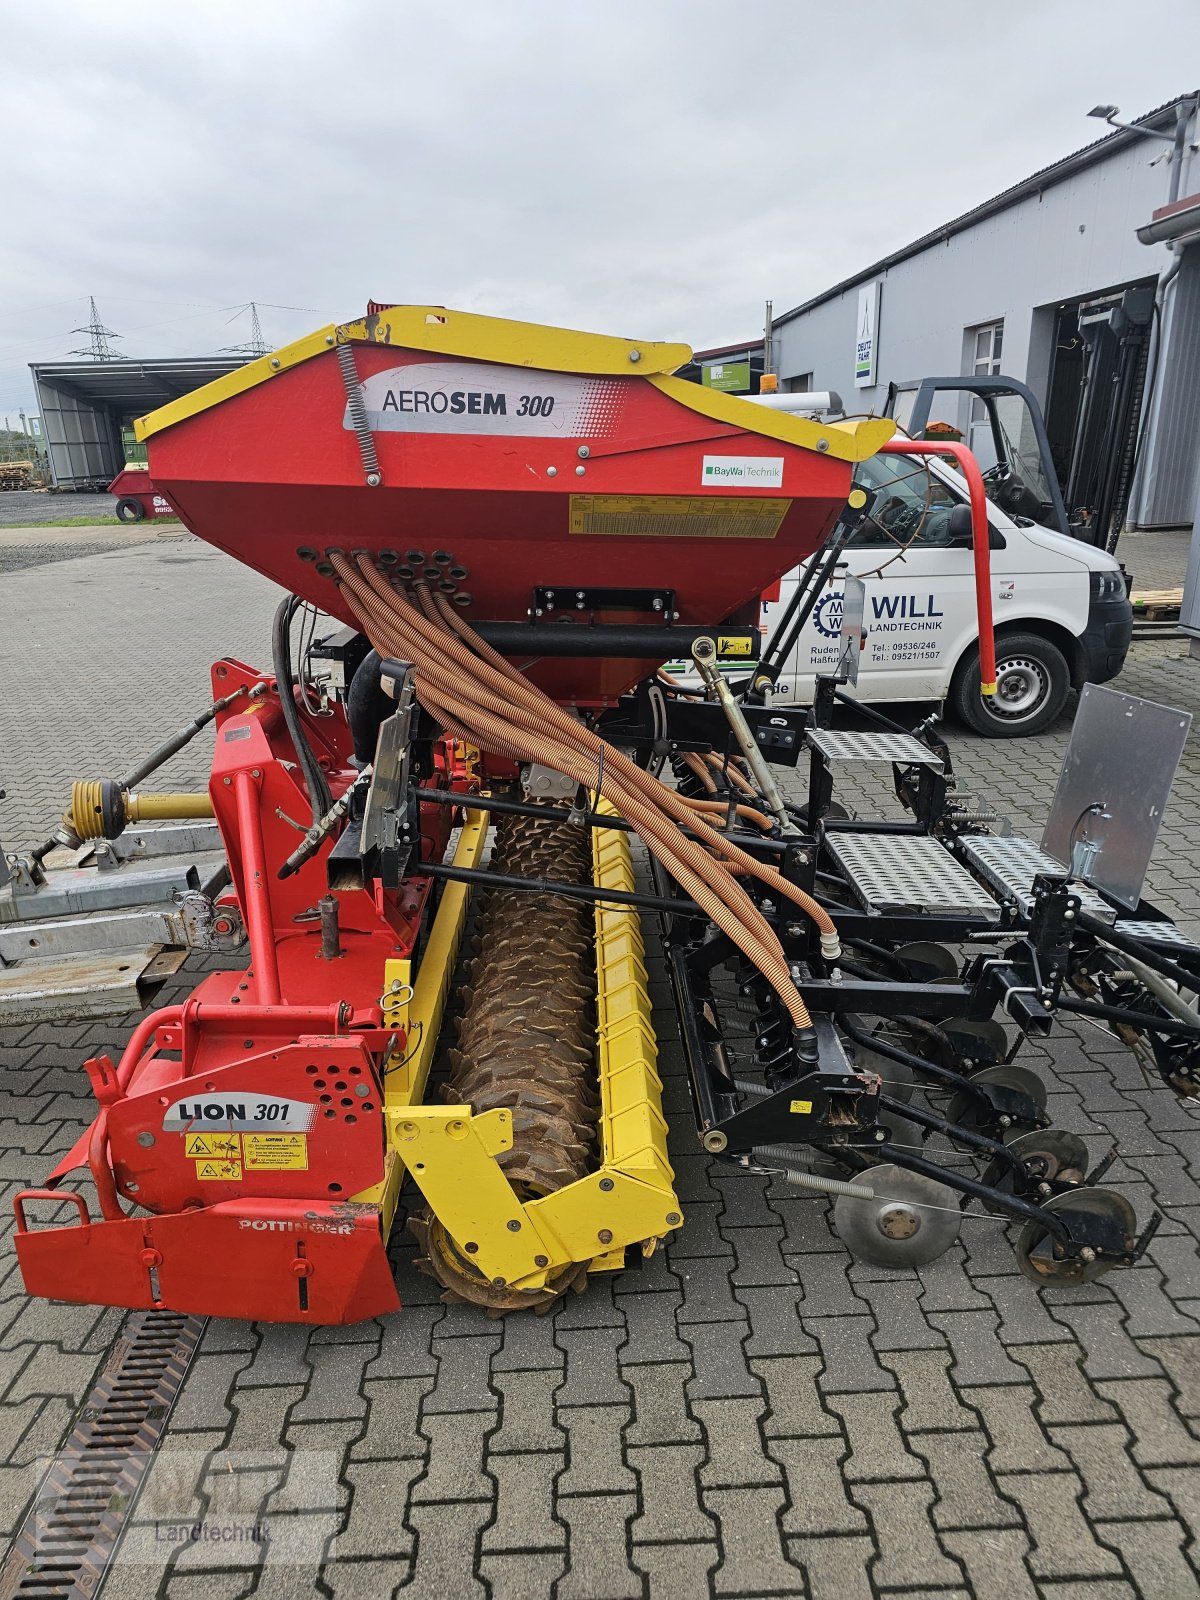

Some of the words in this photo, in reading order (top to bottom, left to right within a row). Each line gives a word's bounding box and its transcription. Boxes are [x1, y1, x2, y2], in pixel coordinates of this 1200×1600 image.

[857, 340, 872, 353] DEUTZ
[858, 350, 870, 361] FAHR
[382, 389, 507, 415] AEROSEM
[516, 395, 555, 417] 300
[714, 466, 743, 477] BayWa
[746, 466, 780, 477] Technik
[871, 594, 944, 619] WILL
[869, 621, 943, 633] LANDTECHNIK
[810, 646, 840, 655] Ruden
[872, 644, 890, 652] Tel.:
[892, 641, 936, 651] 09536/246
[810, 656, 840, 665] Haßfur
[871, 653, 889, 662] Tel.:
[891, 651, 940, 661] 09521/1507
[178, 1103, 247, 1121] LION
[253, 1103, 290, 1121] 301
